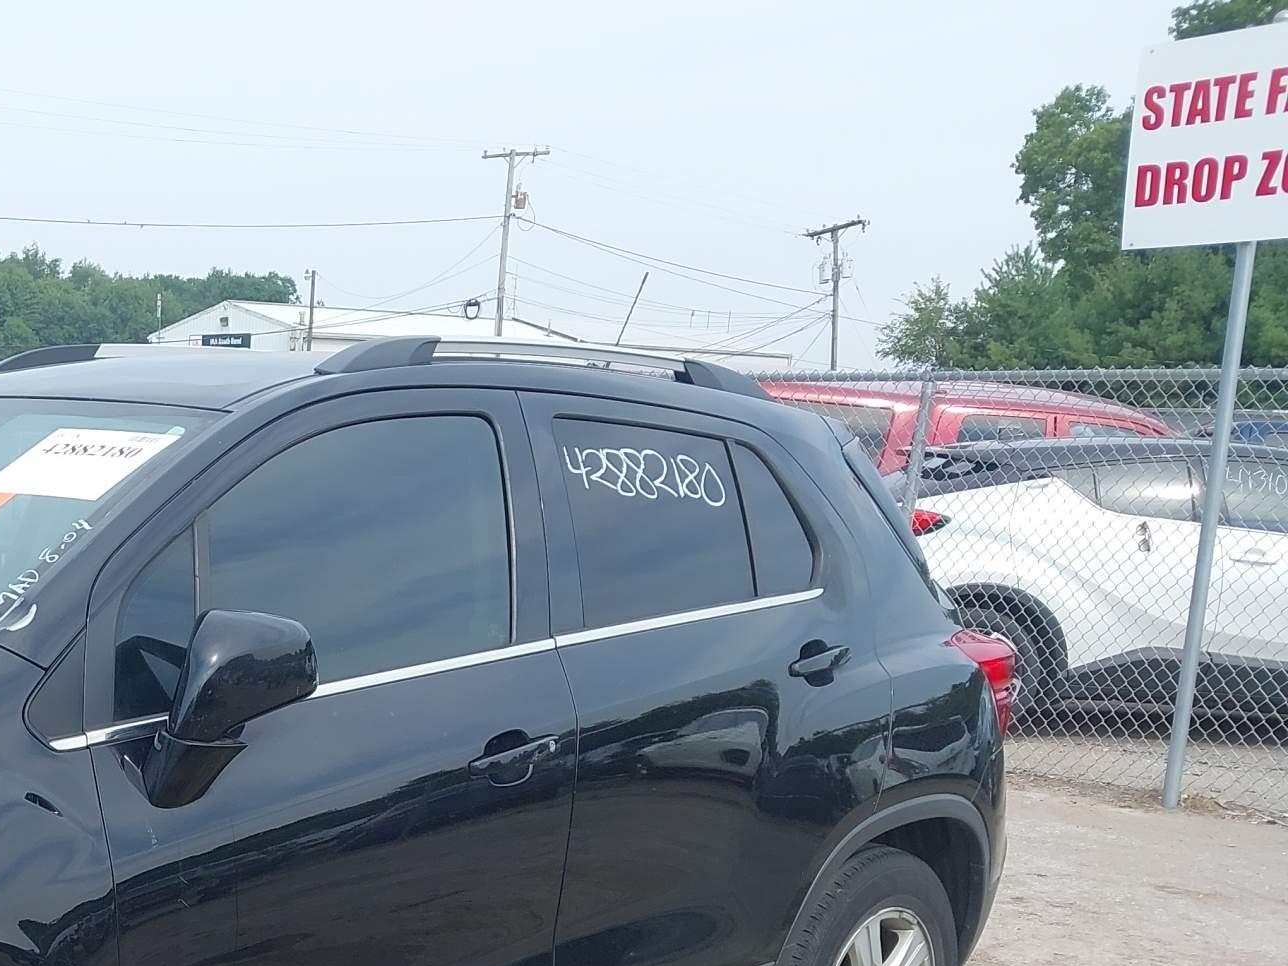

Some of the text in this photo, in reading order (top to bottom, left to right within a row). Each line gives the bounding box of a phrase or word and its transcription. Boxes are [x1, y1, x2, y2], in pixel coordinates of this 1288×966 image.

[1142, 72, 1258, 130] STATE
[1135, 154, 1249, 208] DROP
[563, 446, 726, 506] 42882180
